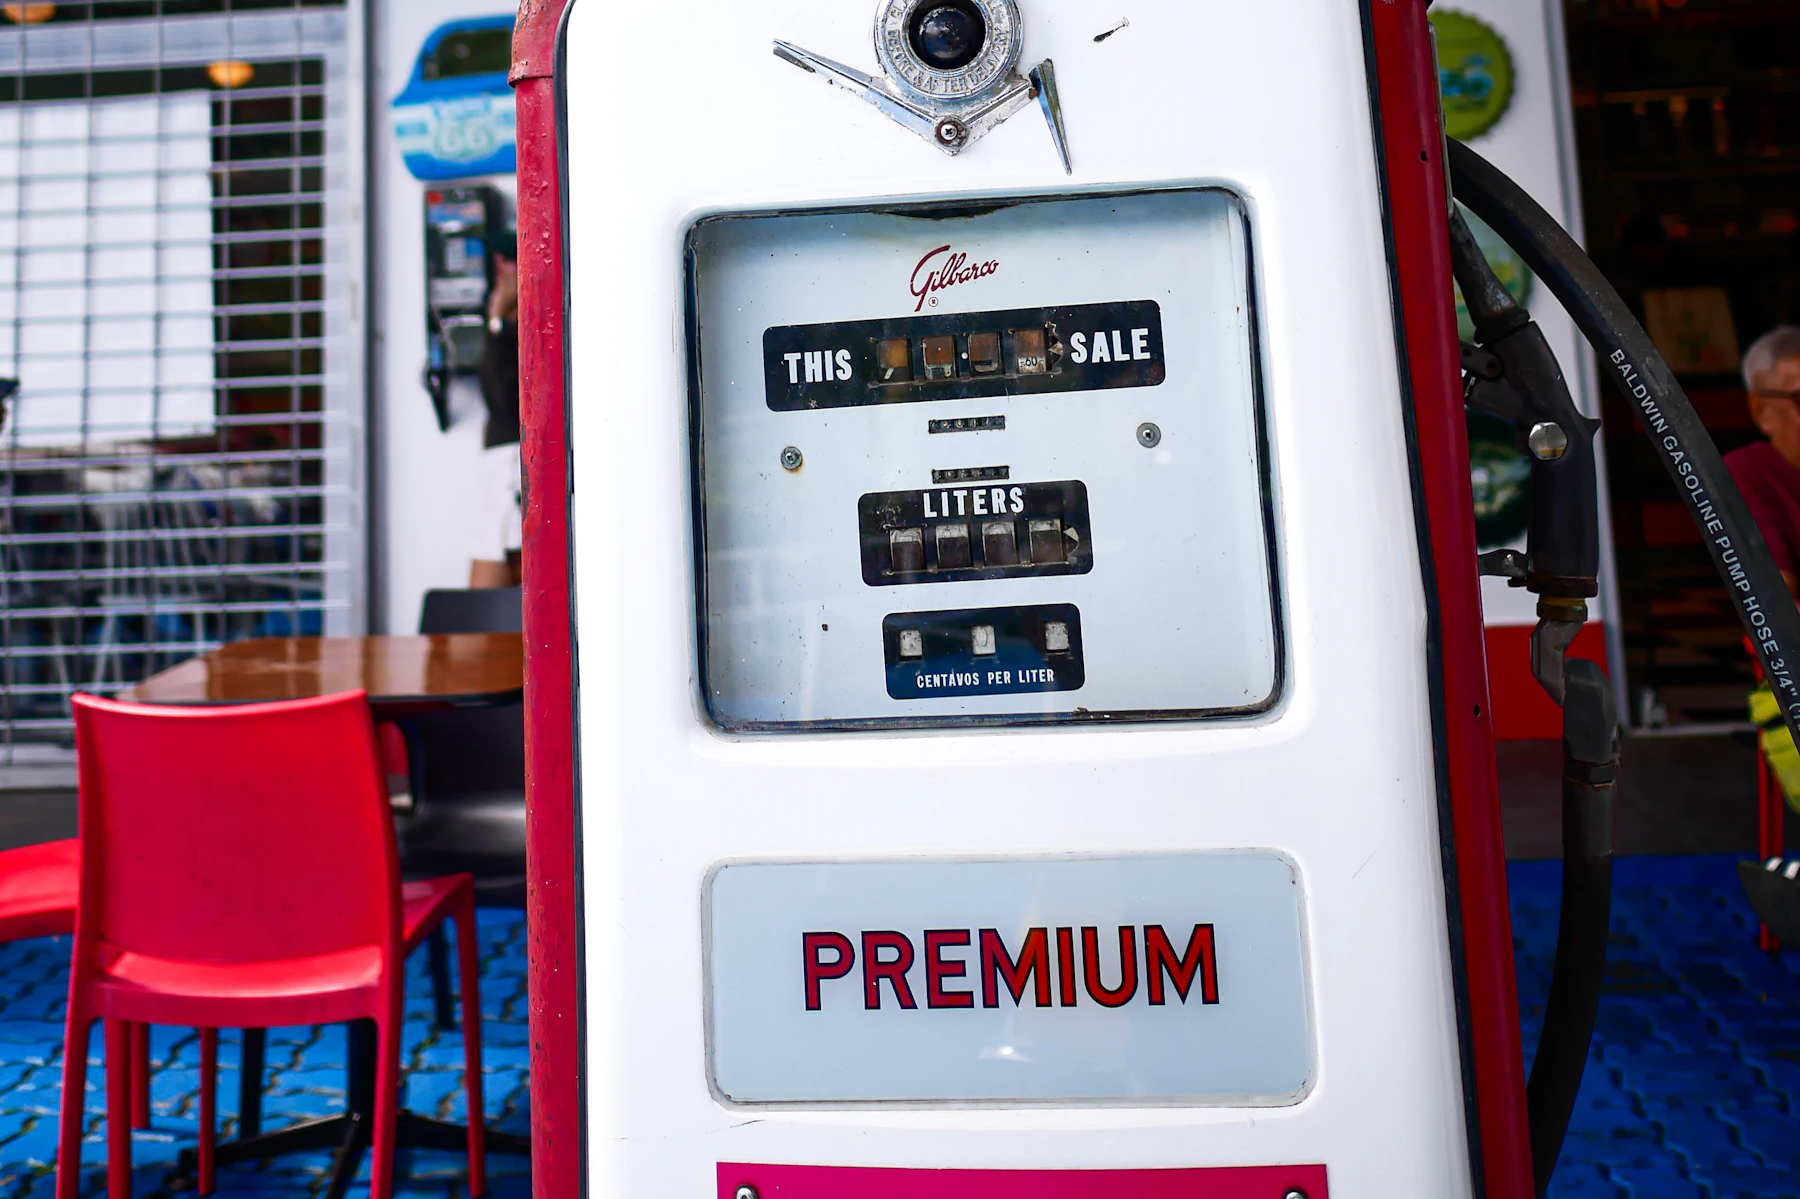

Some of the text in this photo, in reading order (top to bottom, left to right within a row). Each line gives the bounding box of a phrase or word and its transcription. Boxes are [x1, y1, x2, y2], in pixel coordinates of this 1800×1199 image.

[886, 27, 1009, 93] BEFORE & AFTER DELIVERY
[910, 245, 999, 312] Gilbarco
[784, 328, 1151, 384] THIS SALE
[923, 487, 1024, 518] LITERS
[1610, 348, 1669, 433] BALDWIN
[1663, 435, 1723, 534] GASOLINE
[1715, 536, 1750, 593] PUMP
[1743, 596, 1779, 655] HOSE
[1770, 658, 1798, 697] 3/4"
[987, 670, 1011, 685] PER
[1018, 668, 1055, 684] LITER
[802, 923, 1220, 1011] PREMIUM
